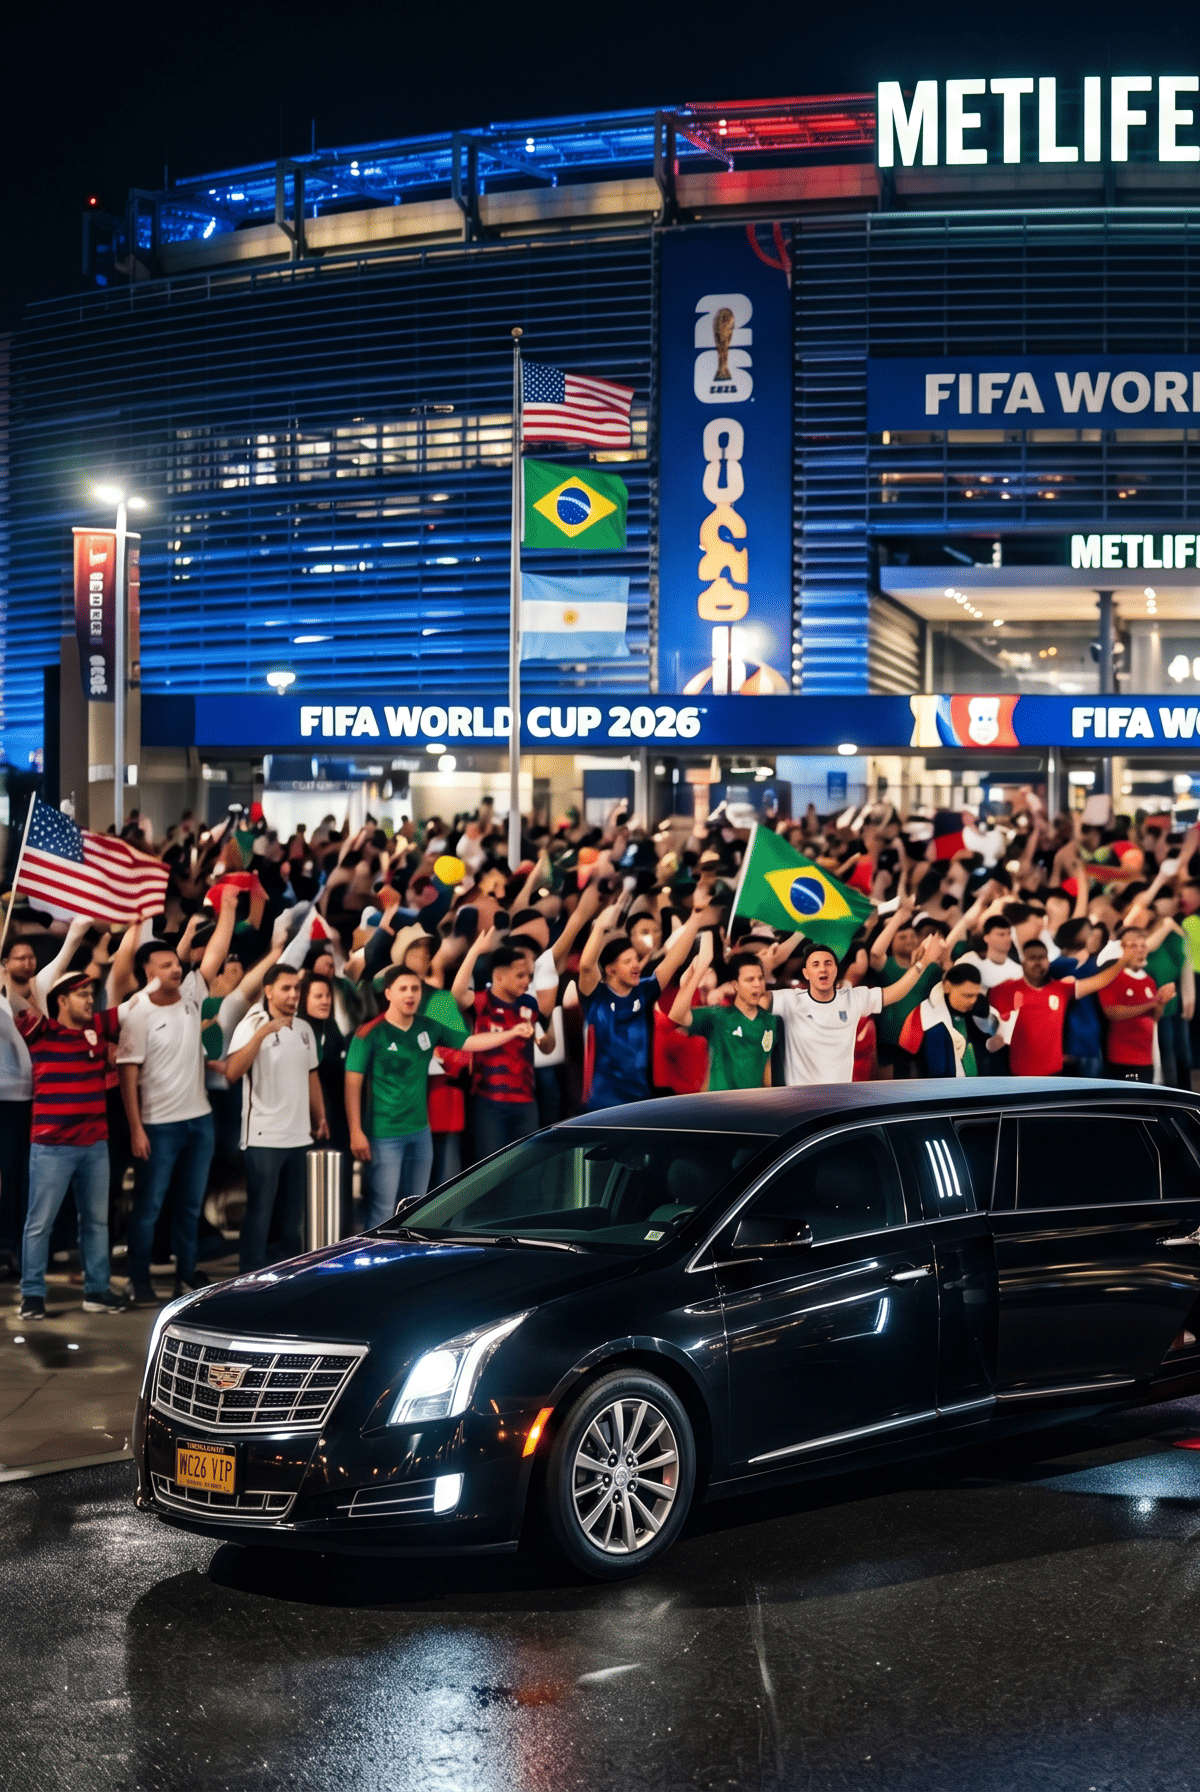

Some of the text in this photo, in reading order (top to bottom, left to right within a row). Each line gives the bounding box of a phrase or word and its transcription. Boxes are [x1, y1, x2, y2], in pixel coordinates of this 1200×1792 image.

[924, 372, 1045, 415] FIFA
[300, 705, 701, 738] FIFA WORLD CUP 2026
[1071, 706, 1155, 739] FIFA
[179, 1452, 233, 1482] WC26 VIP
